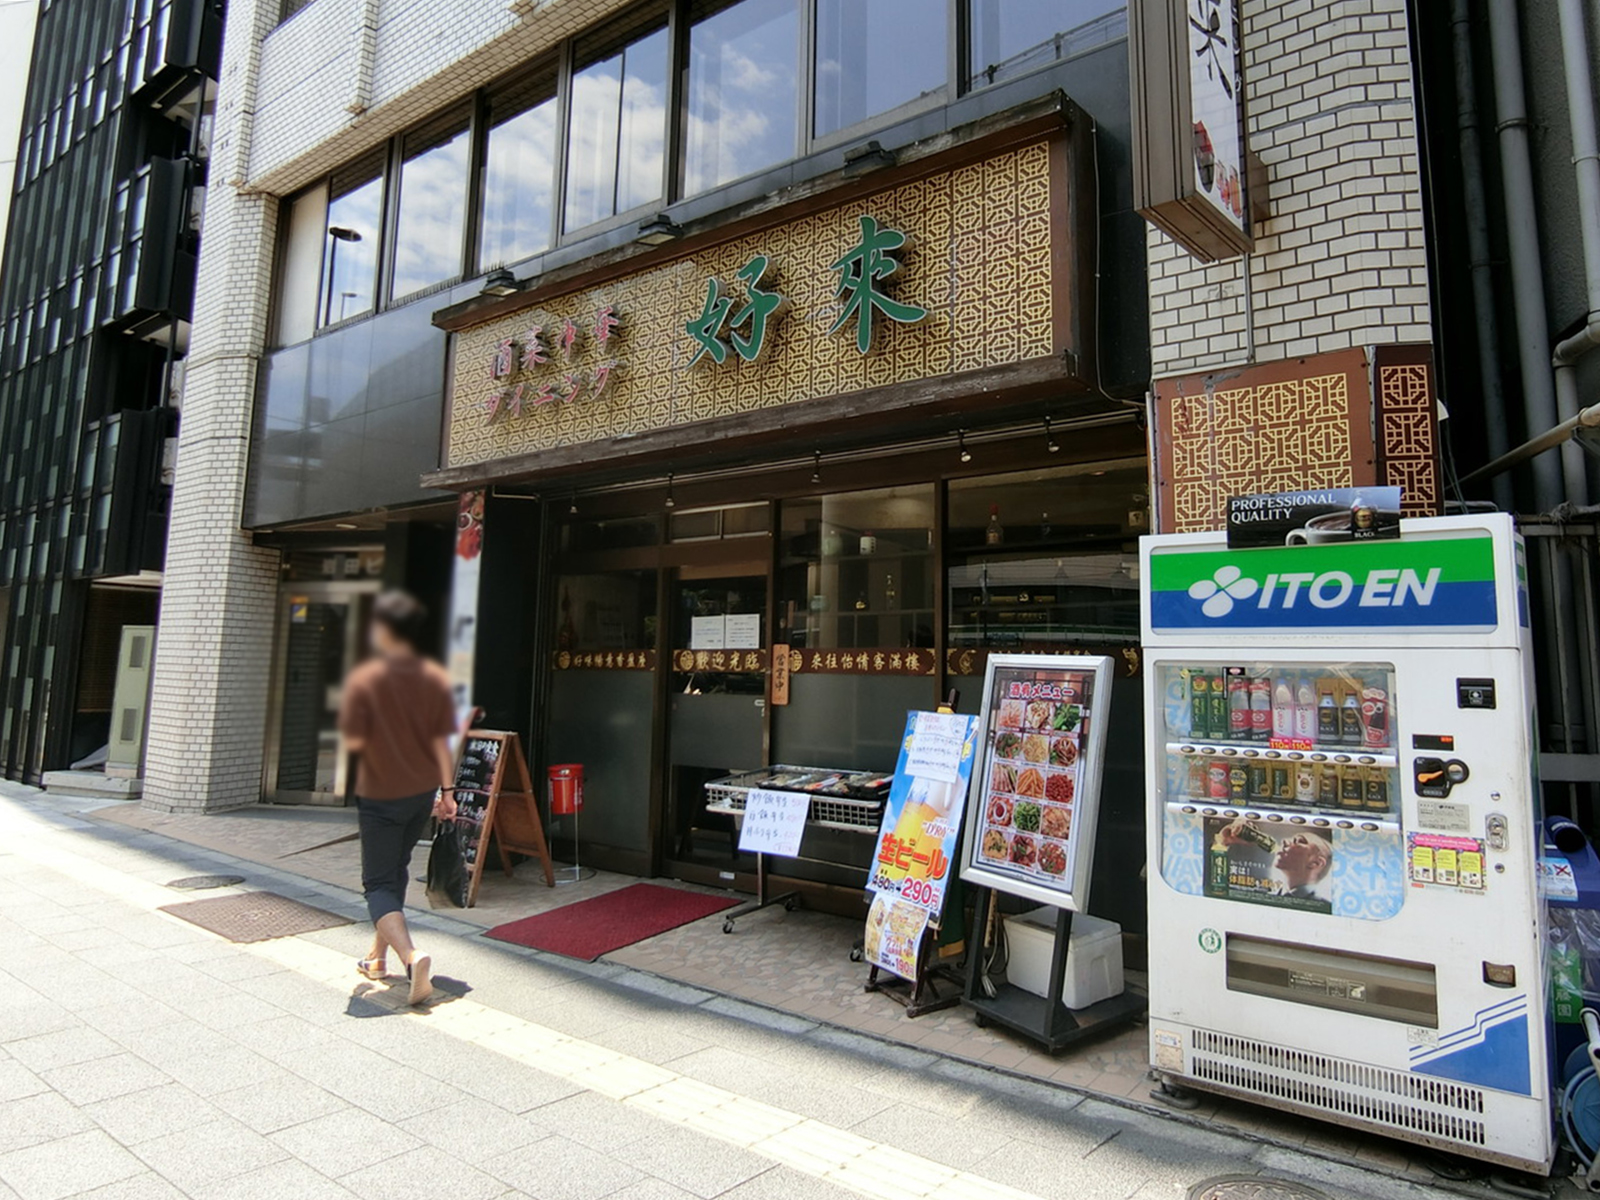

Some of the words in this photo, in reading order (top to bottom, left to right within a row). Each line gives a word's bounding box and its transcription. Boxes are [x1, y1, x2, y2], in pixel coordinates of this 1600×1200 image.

[483, 359, 618, 427] ダイニング
[1231, 493, 1337, 511] PROFESSIONAL
[1231, 508, 1293, 524] QUALITY
[1257, 571, 1354, 609] ITO
[1358, 567, 1442, 607] EN
[878, 832, 949, 880] 生ビール
[901, 876, 939, 910] 290円
